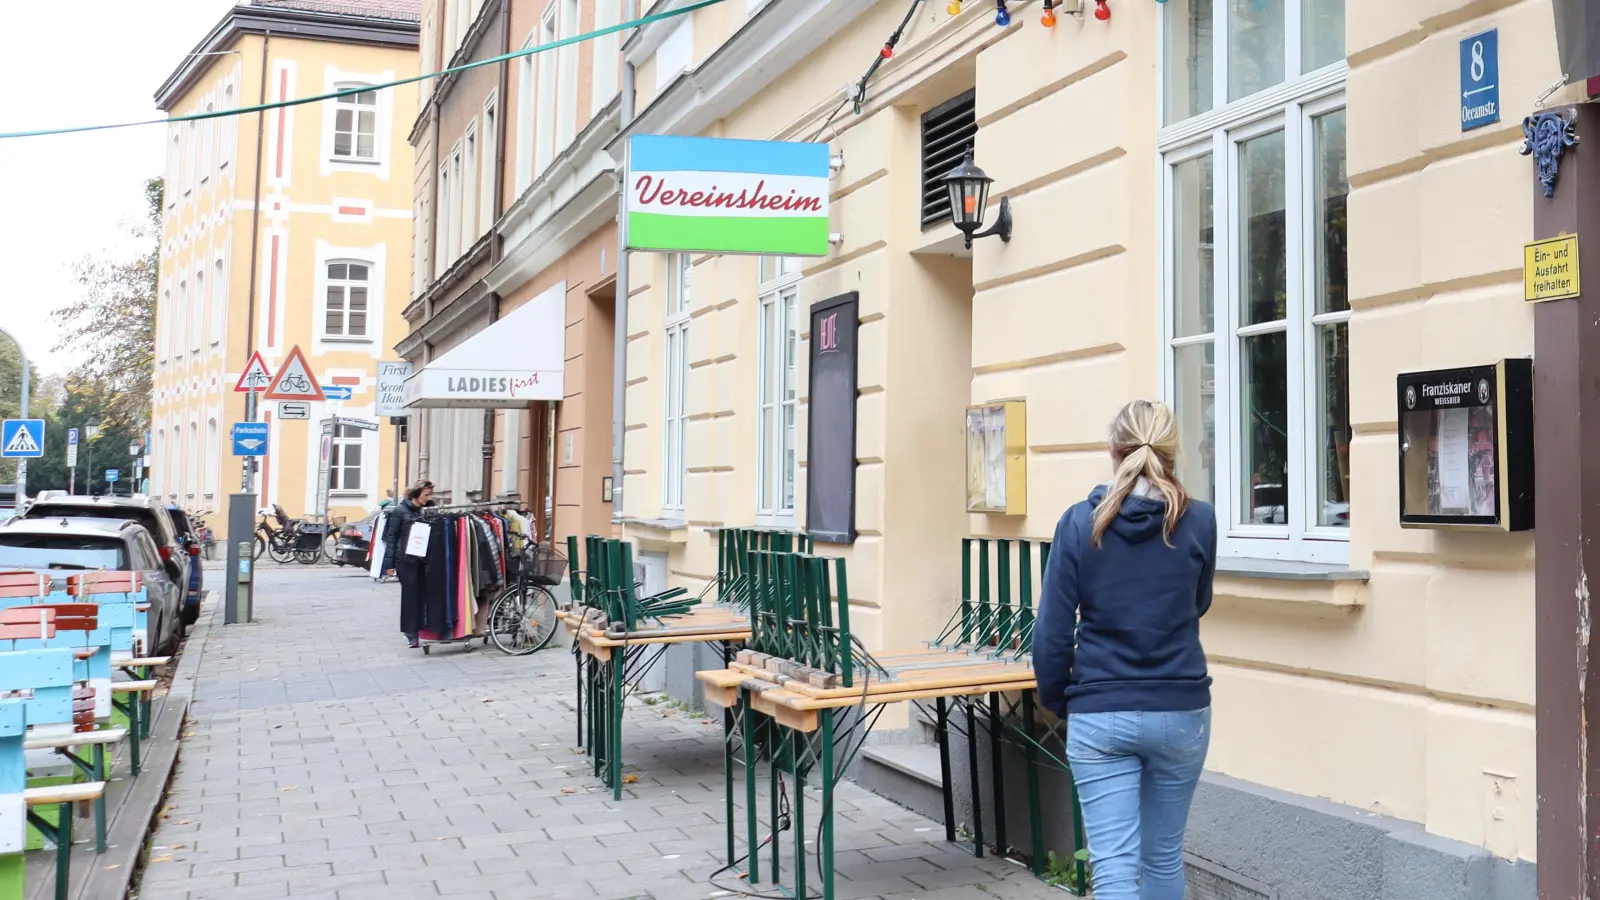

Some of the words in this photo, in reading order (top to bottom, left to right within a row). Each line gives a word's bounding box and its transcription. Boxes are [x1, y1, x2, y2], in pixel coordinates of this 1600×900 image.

[1470, 40, 1484, 82] 8
[1462, 100, 1496, 123] Occamstr.
[635, 175, 822, 212] Vereinsheim
[1534, 251, 1550, 262] Ein-
[1553, 243, 1568, 260] und
[1535, 262, 1568, 277] Ausfahrt
[1533, 279, 1571, 292] freihalten
[382, 365, 407, 376] First
[379, 381, 405, 393] Secon
[447, 376, 507, 393] LADIES
[509, 372, 539, 397] first
[1422, 381, 1472, 397] Franziskaner
[381, 393, 404, 403] Han
[1434, 396, 1461, 405] WEISSBIER
